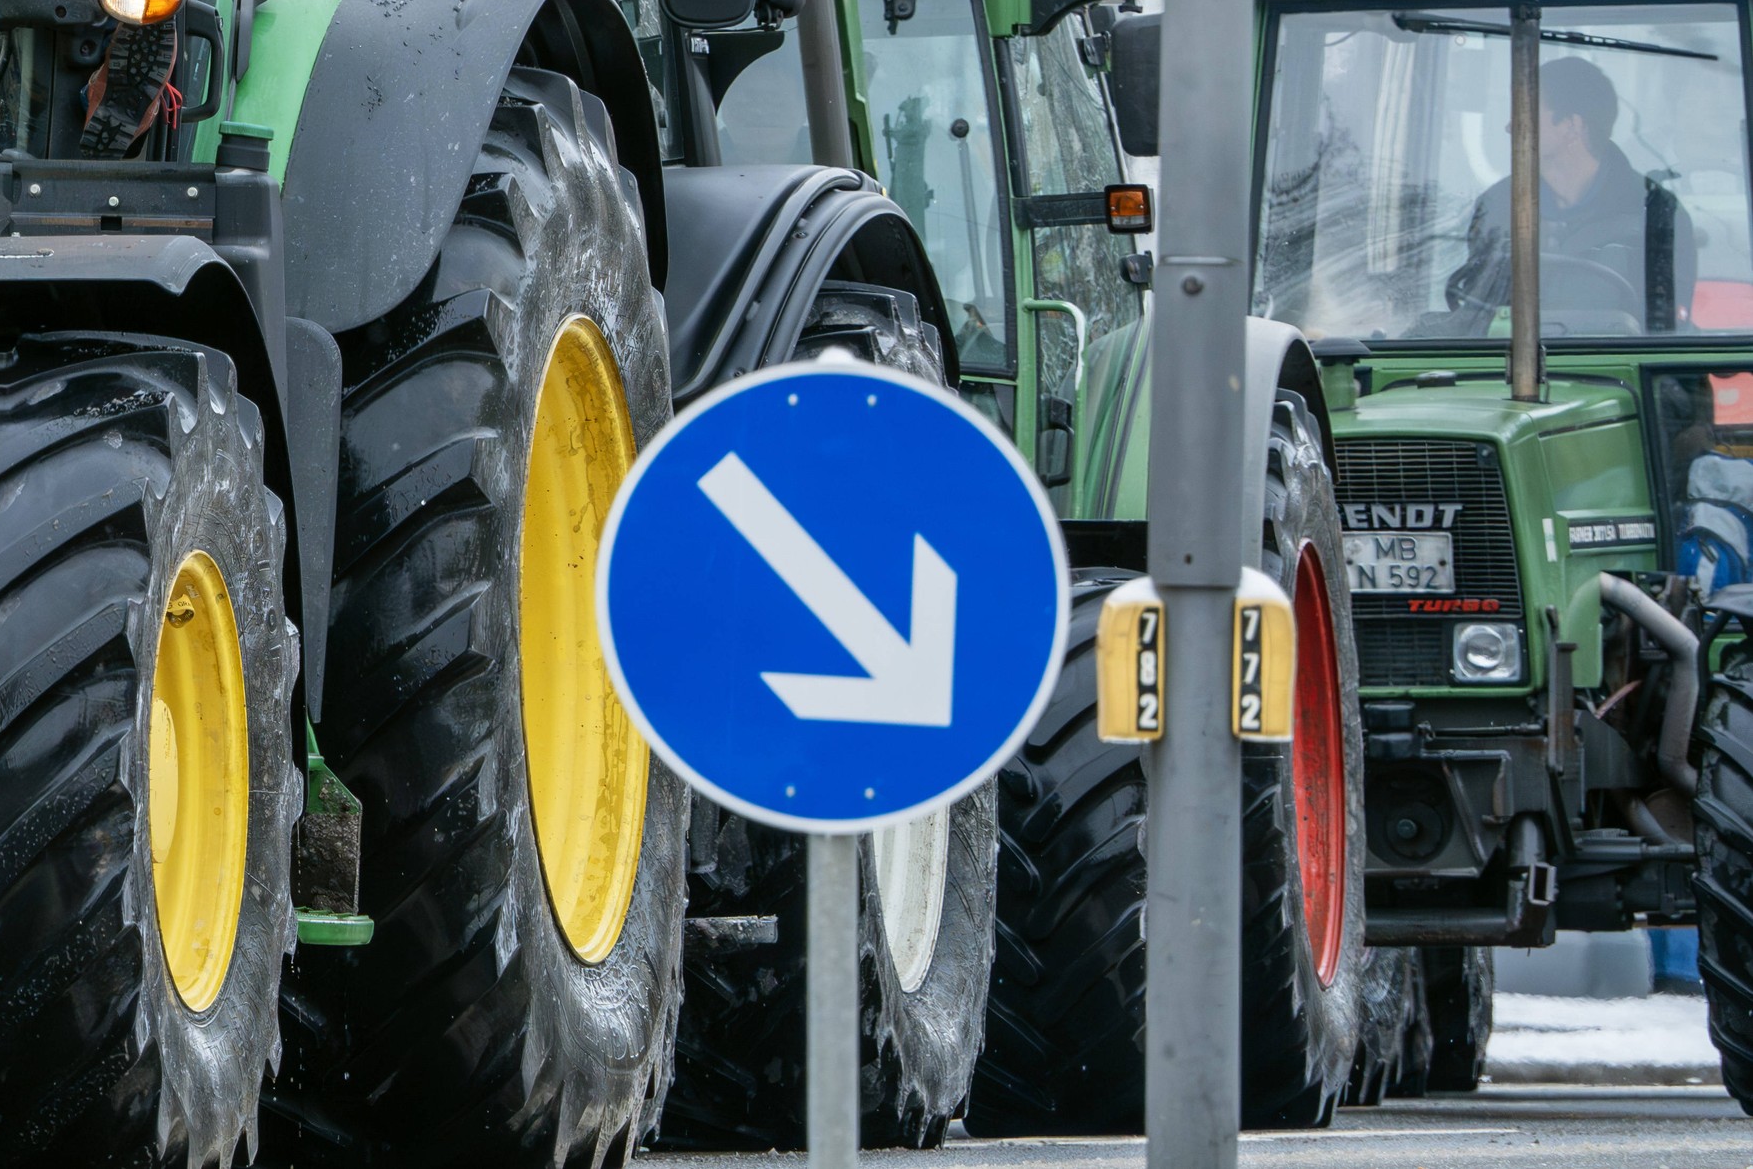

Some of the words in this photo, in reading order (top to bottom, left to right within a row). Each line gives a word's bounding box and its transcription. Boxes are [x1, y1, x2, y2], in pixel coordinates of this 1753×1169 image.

[1337, 503, 1464, 529] ENDT
[1375, 536, 1417, 561] MB
[1357, 564, 1377, 589] N
[1389, 564, 1439, 589] 592
[1407, 598, 1500, 613] TURBO
[1137, 609, 1160, 730] 782
[1240, 608, 1263, 730] 772
